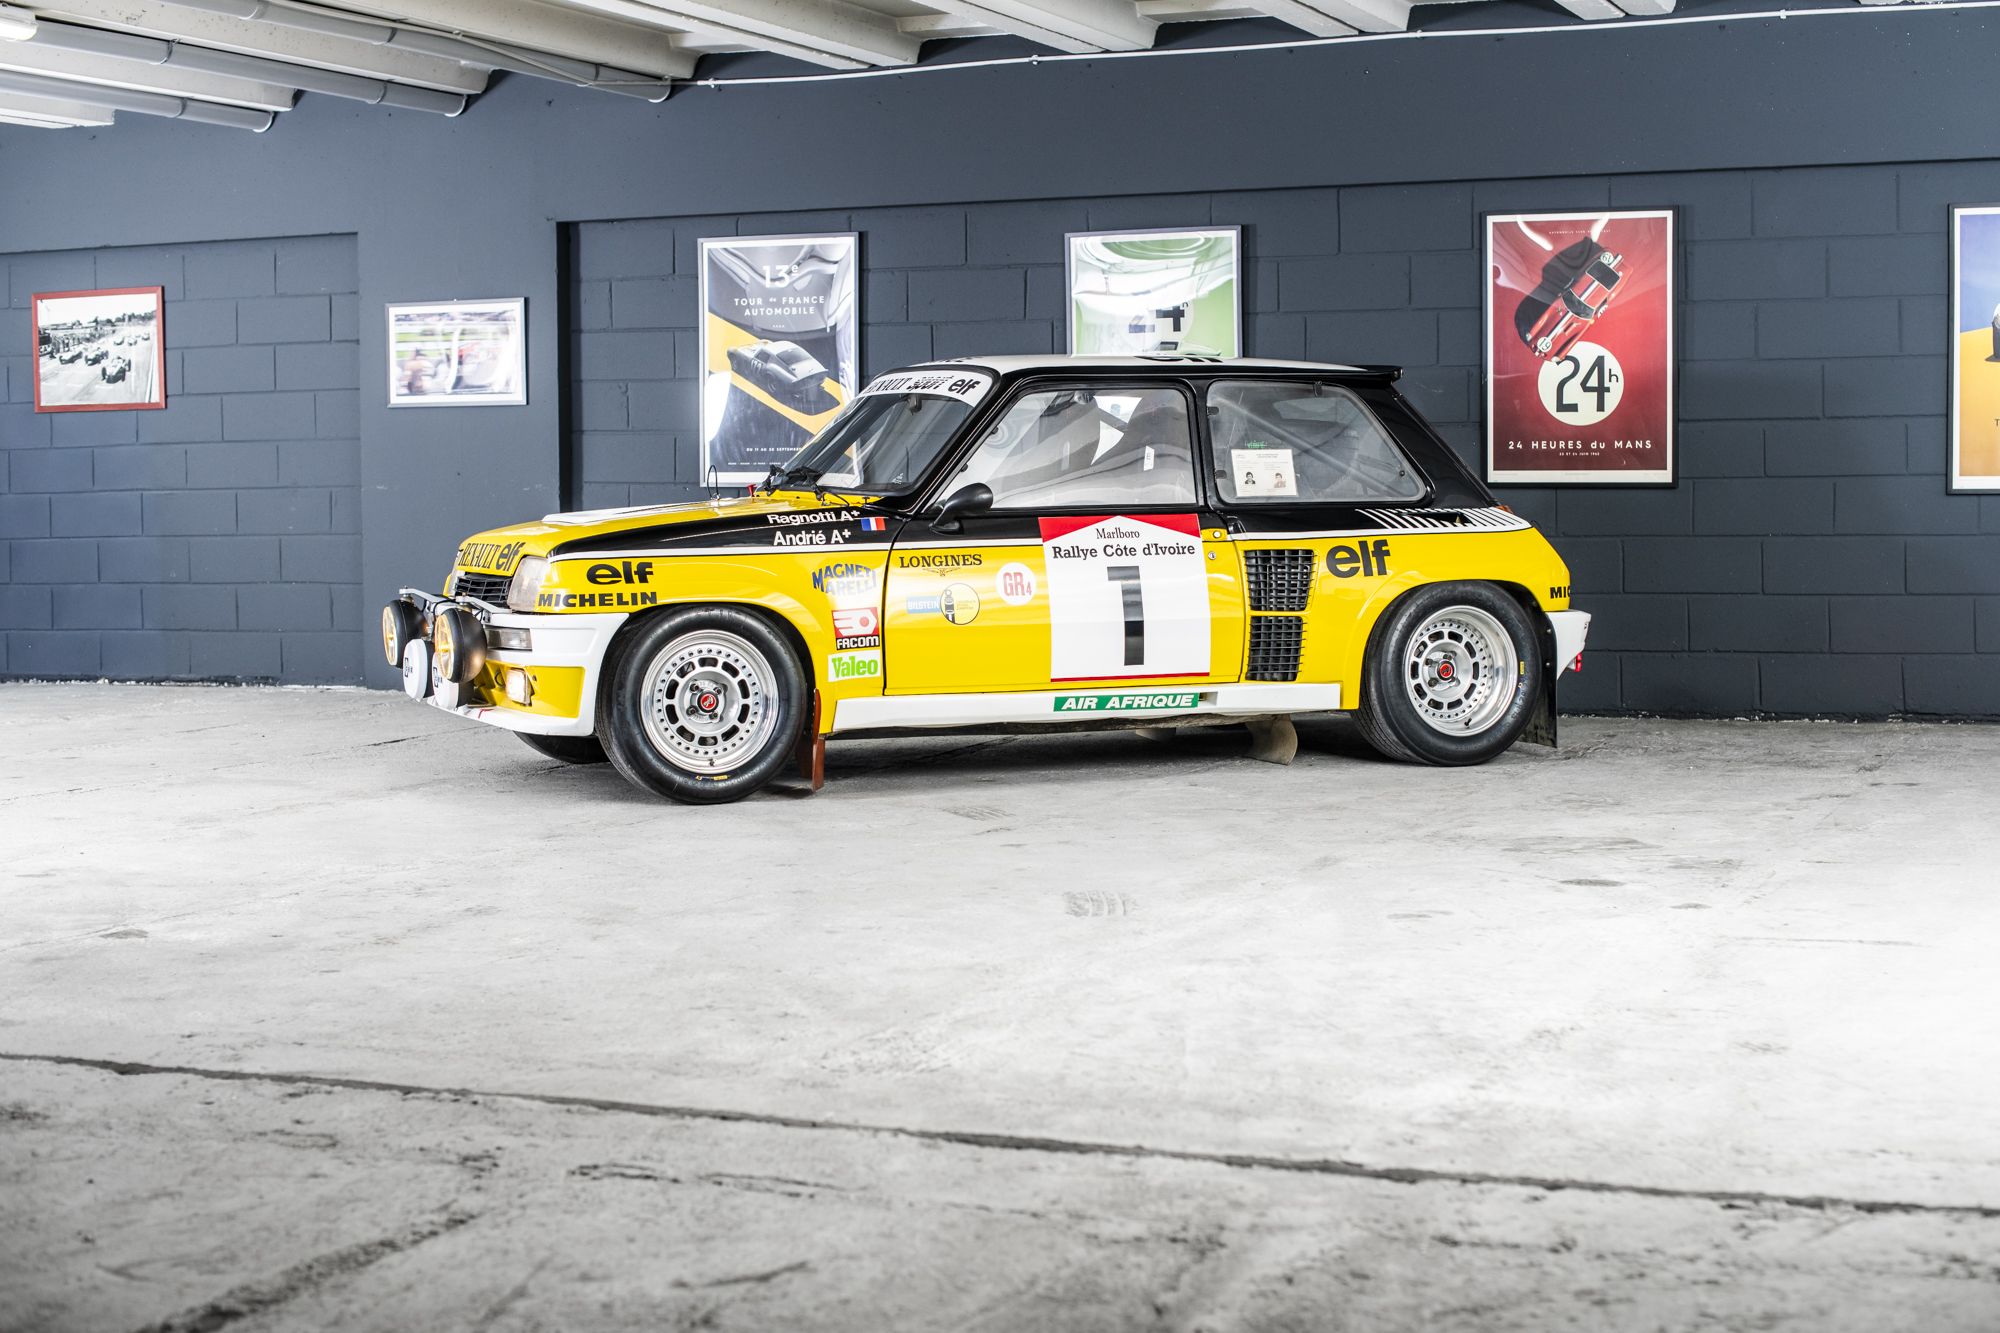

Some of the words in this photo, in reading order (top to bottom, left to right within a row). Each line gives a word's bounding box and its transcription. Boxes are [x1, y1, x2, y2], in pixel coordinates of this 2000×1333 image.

[734, 298, 762, 306] TOUR
[782, 296, 825, 304] FRANCE
[744, 307, 815, 316] AUTOMOBILE
[947, 378, 981, 395] elf
[1508, 441, 1522, 450] 24
[1531, 440, 1582, 450] HEURES
[1590, 440, 1606, 449] du
[1614, 440, 1652, 449] MANS
[767, 511, 835, 525] Ragnotti
[773, 529, 826, 546] Andrié
[1096, 527, 1140, 539] Marlboro
[458, 542, 502, 569] RENAULT
[495, 541, 526, 571] elf
[1052, 545, 1098, 561] Rallye
[1103, 543, 1137, 557] Côte
[1142, 542, 1196, 556] d'Ivoire
[1325, 539, 1391, 578] elf
[899, 553, 983, 568] LONGINES
[586, 560, 654, 586] elf
[812, 563, 877, 592] MAGNETI
[538, 592, 658, 608] MICHELIN
[1106, 565, 1145, 666] 1
[836, 635, 880, 650] FACOM
[831, 655, 879, 679] Valeo
[1061, 696, 1098, 710] AIR
[1105, 693, 1195, 709] AFRIQUE
